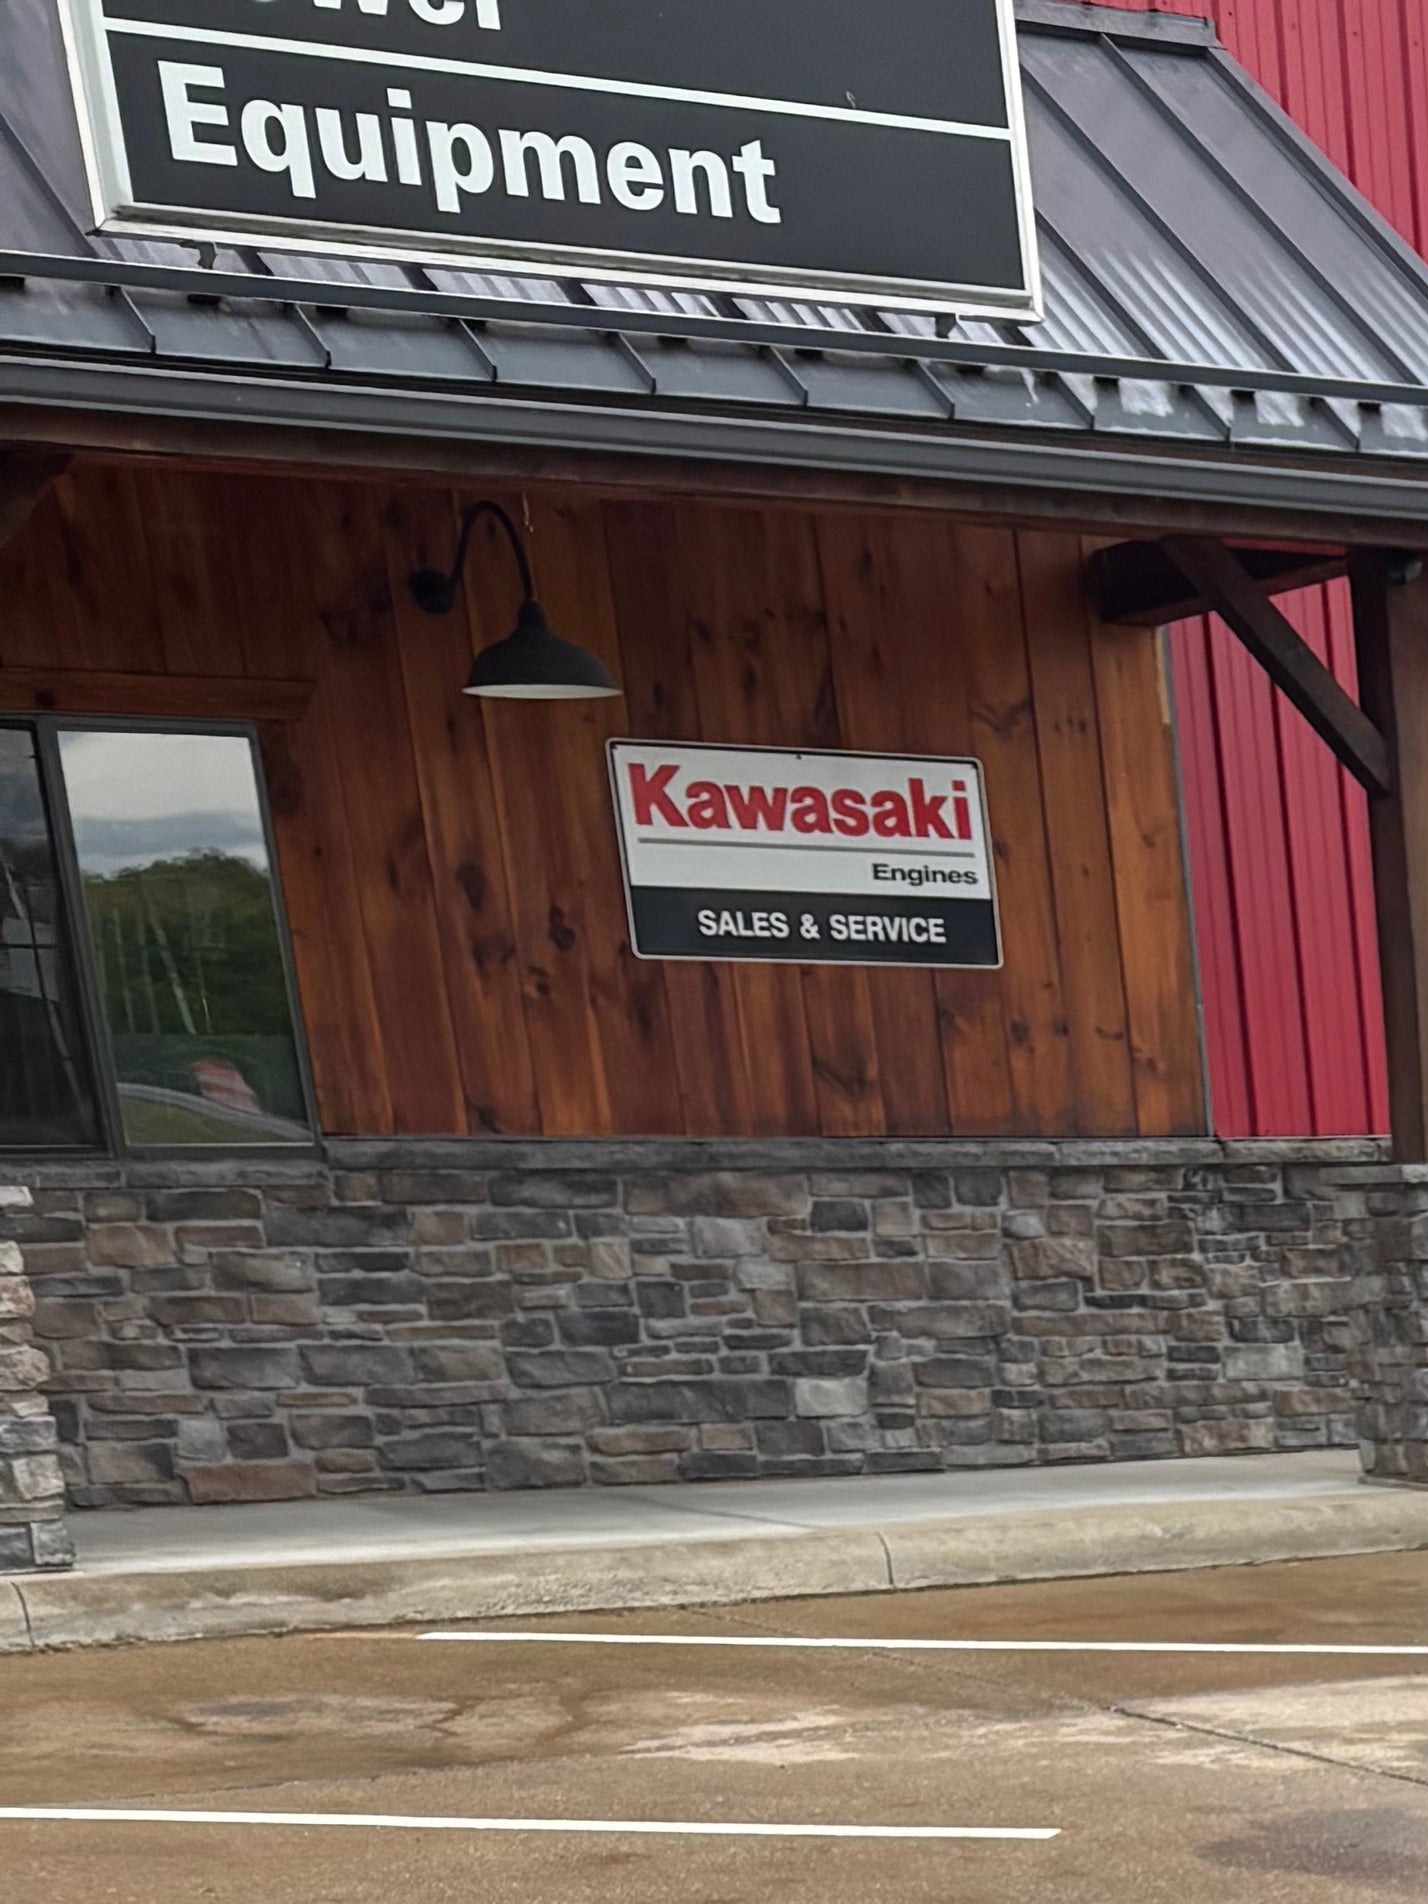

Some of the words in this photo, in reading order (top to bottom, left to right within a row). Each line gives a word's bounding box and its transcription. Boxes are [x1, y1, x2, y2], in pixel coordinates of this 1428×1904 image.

[157, 59, 781, 224] Equipment
[627, 763, 973, 841] Kawasaki
[871, 863, 979, 887] Engines
[697, 909, 790, 939] SALES
[800, 914, 821, 940] &
[830, 914, 947, 944] SERVICE
